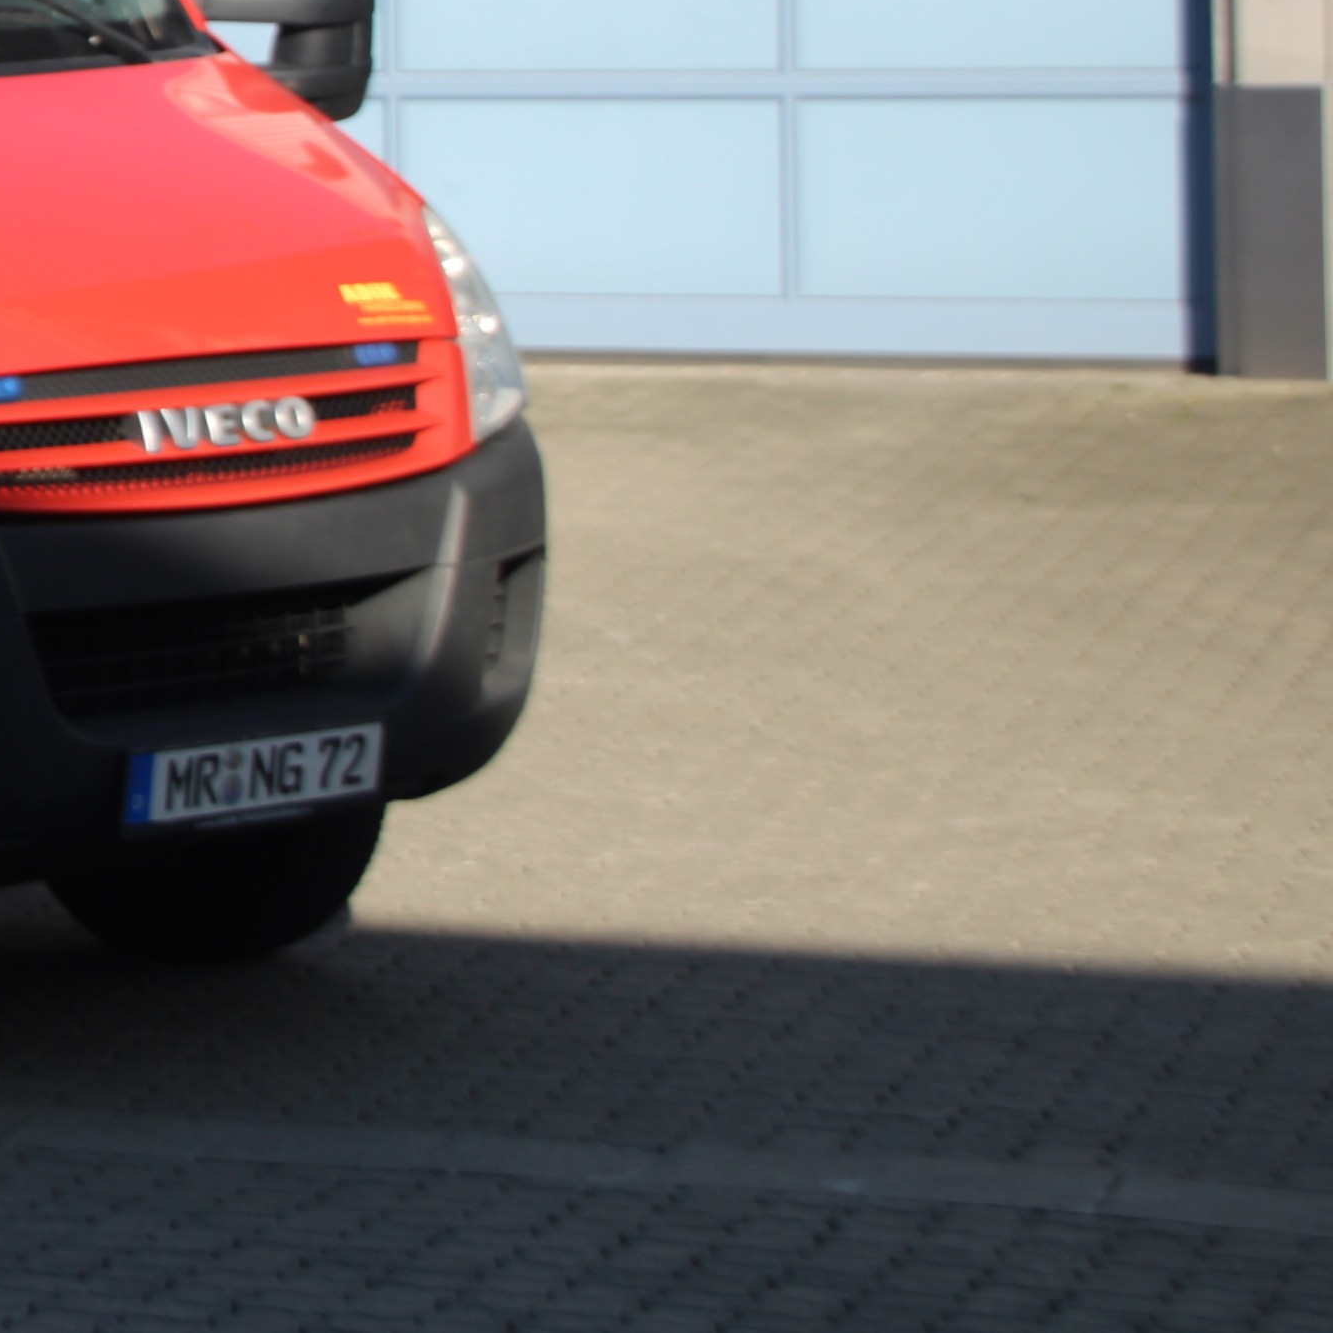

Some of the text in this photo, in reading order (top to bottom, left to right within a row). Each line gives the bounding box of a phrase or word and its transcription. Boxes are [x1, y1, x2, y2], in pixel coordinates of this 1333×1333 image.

[137, 395, 315, 453] IVECO
[164, 732, 366, 811] MR NG 72
